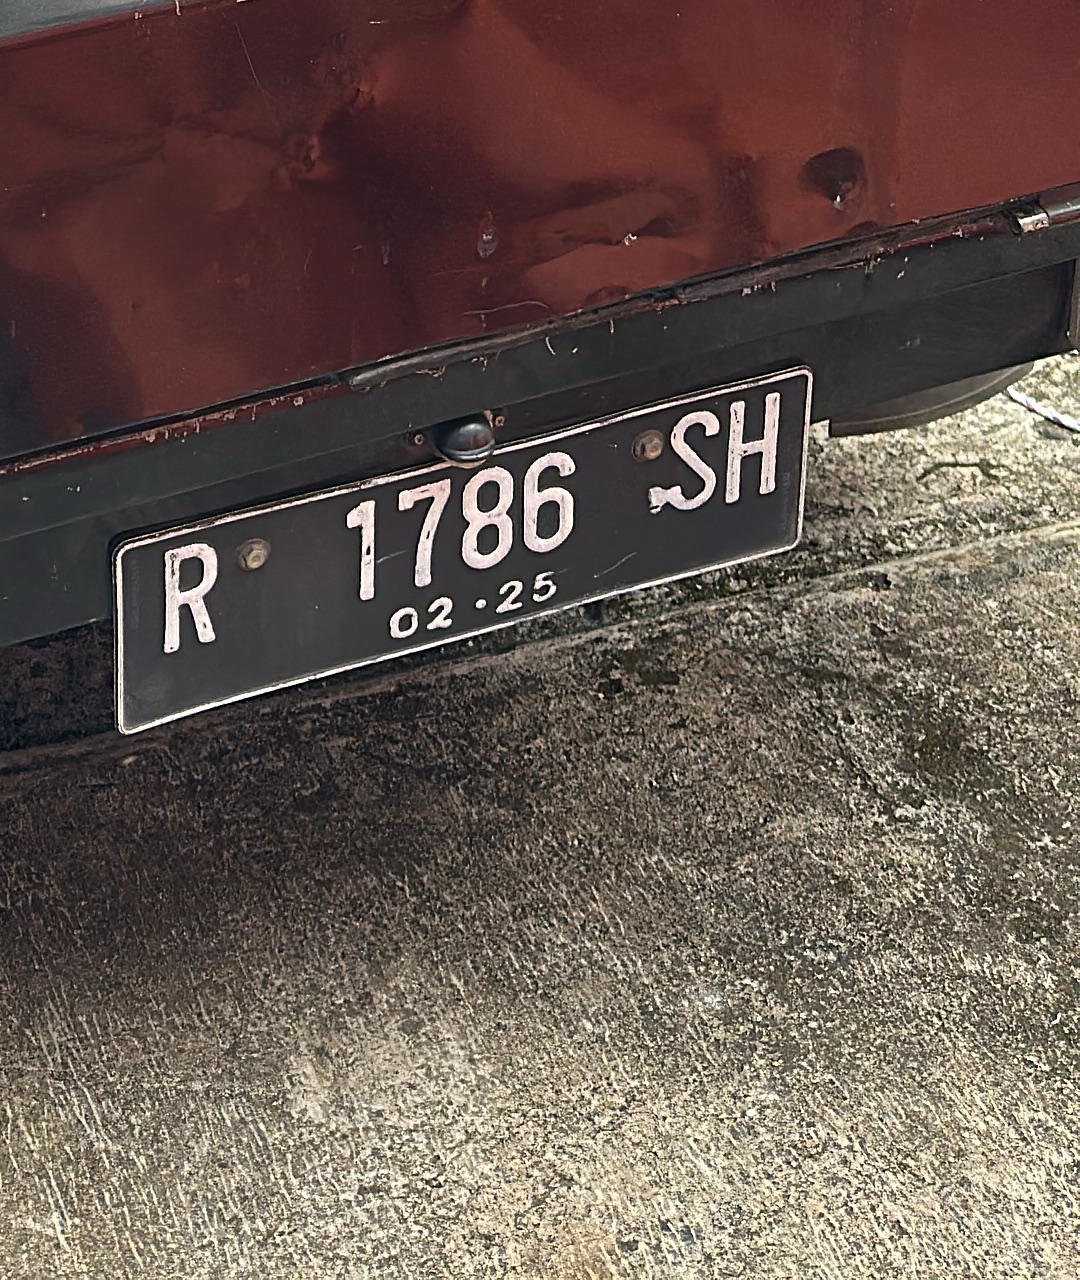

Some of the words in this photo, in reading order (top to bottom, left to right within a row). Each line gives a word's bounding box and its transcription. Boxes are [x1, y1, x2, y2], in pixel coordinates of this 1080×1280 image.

[162, 542, 218, 654] R
[345, 450, 576, 602] 1786
[647, 391, 780, 514] SH
